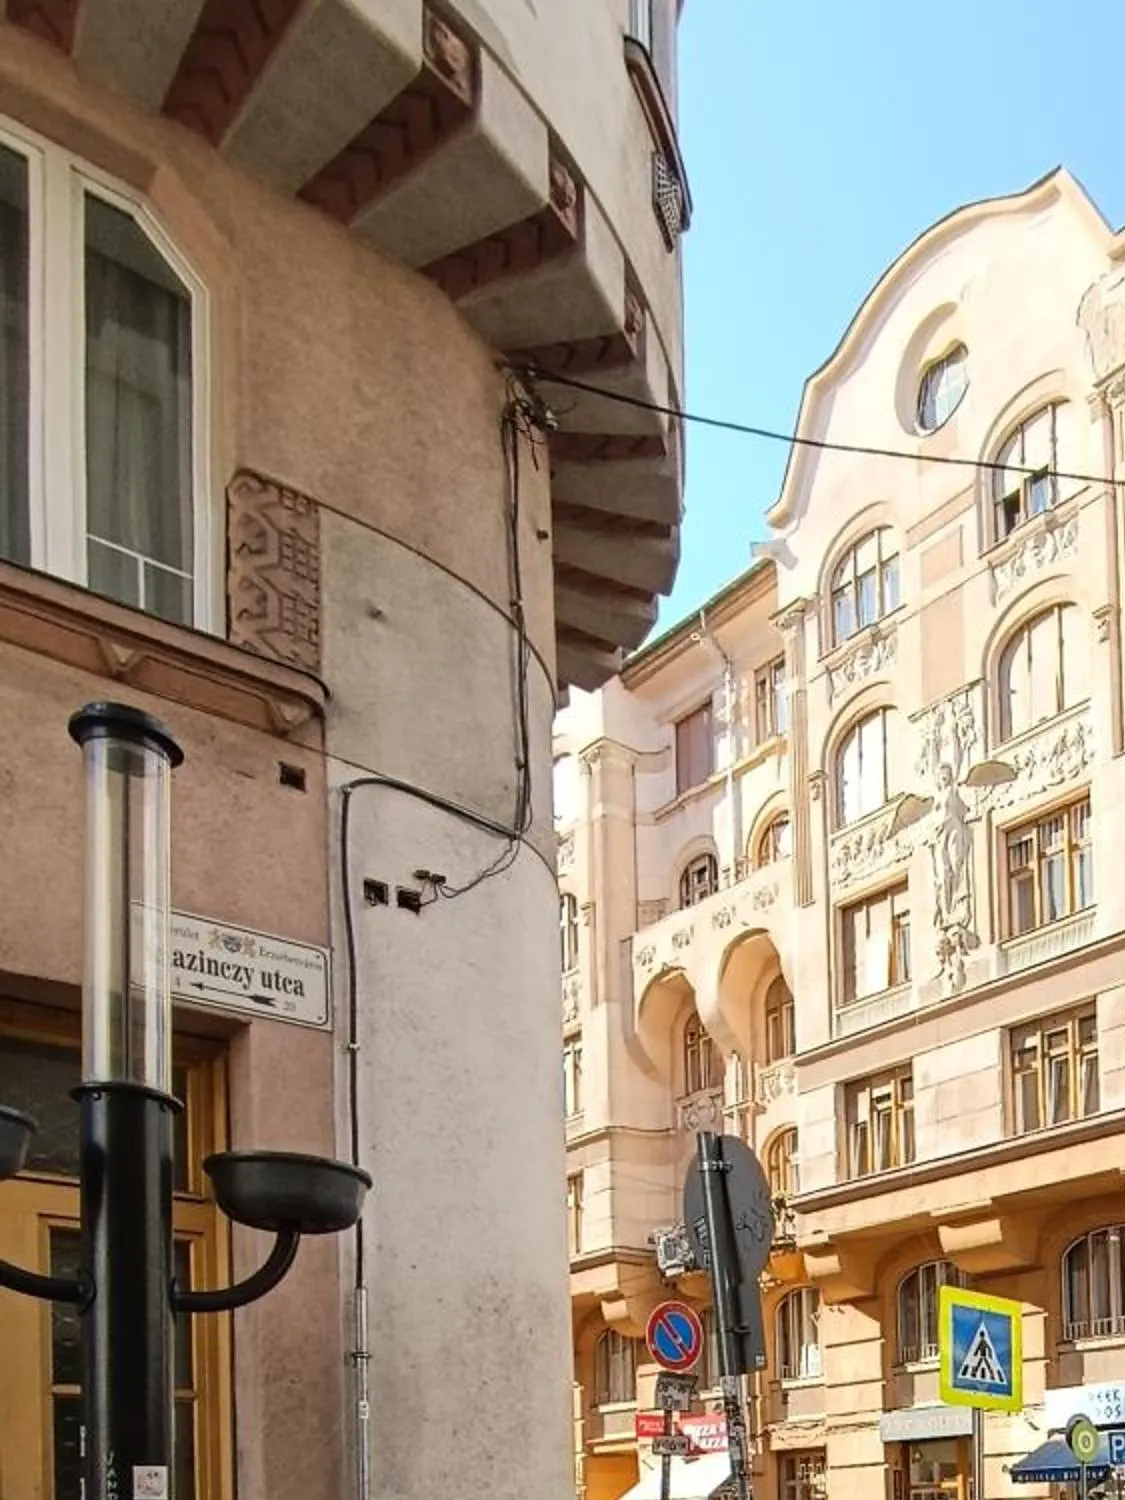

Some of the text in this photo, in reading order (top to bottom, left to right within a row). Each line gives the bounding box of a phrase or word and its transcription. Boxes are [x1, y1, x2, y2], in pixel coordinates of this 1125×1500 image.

[172, 949, 305, 997] azinczy utca
[1111, 1434, 1125, 1461] P
